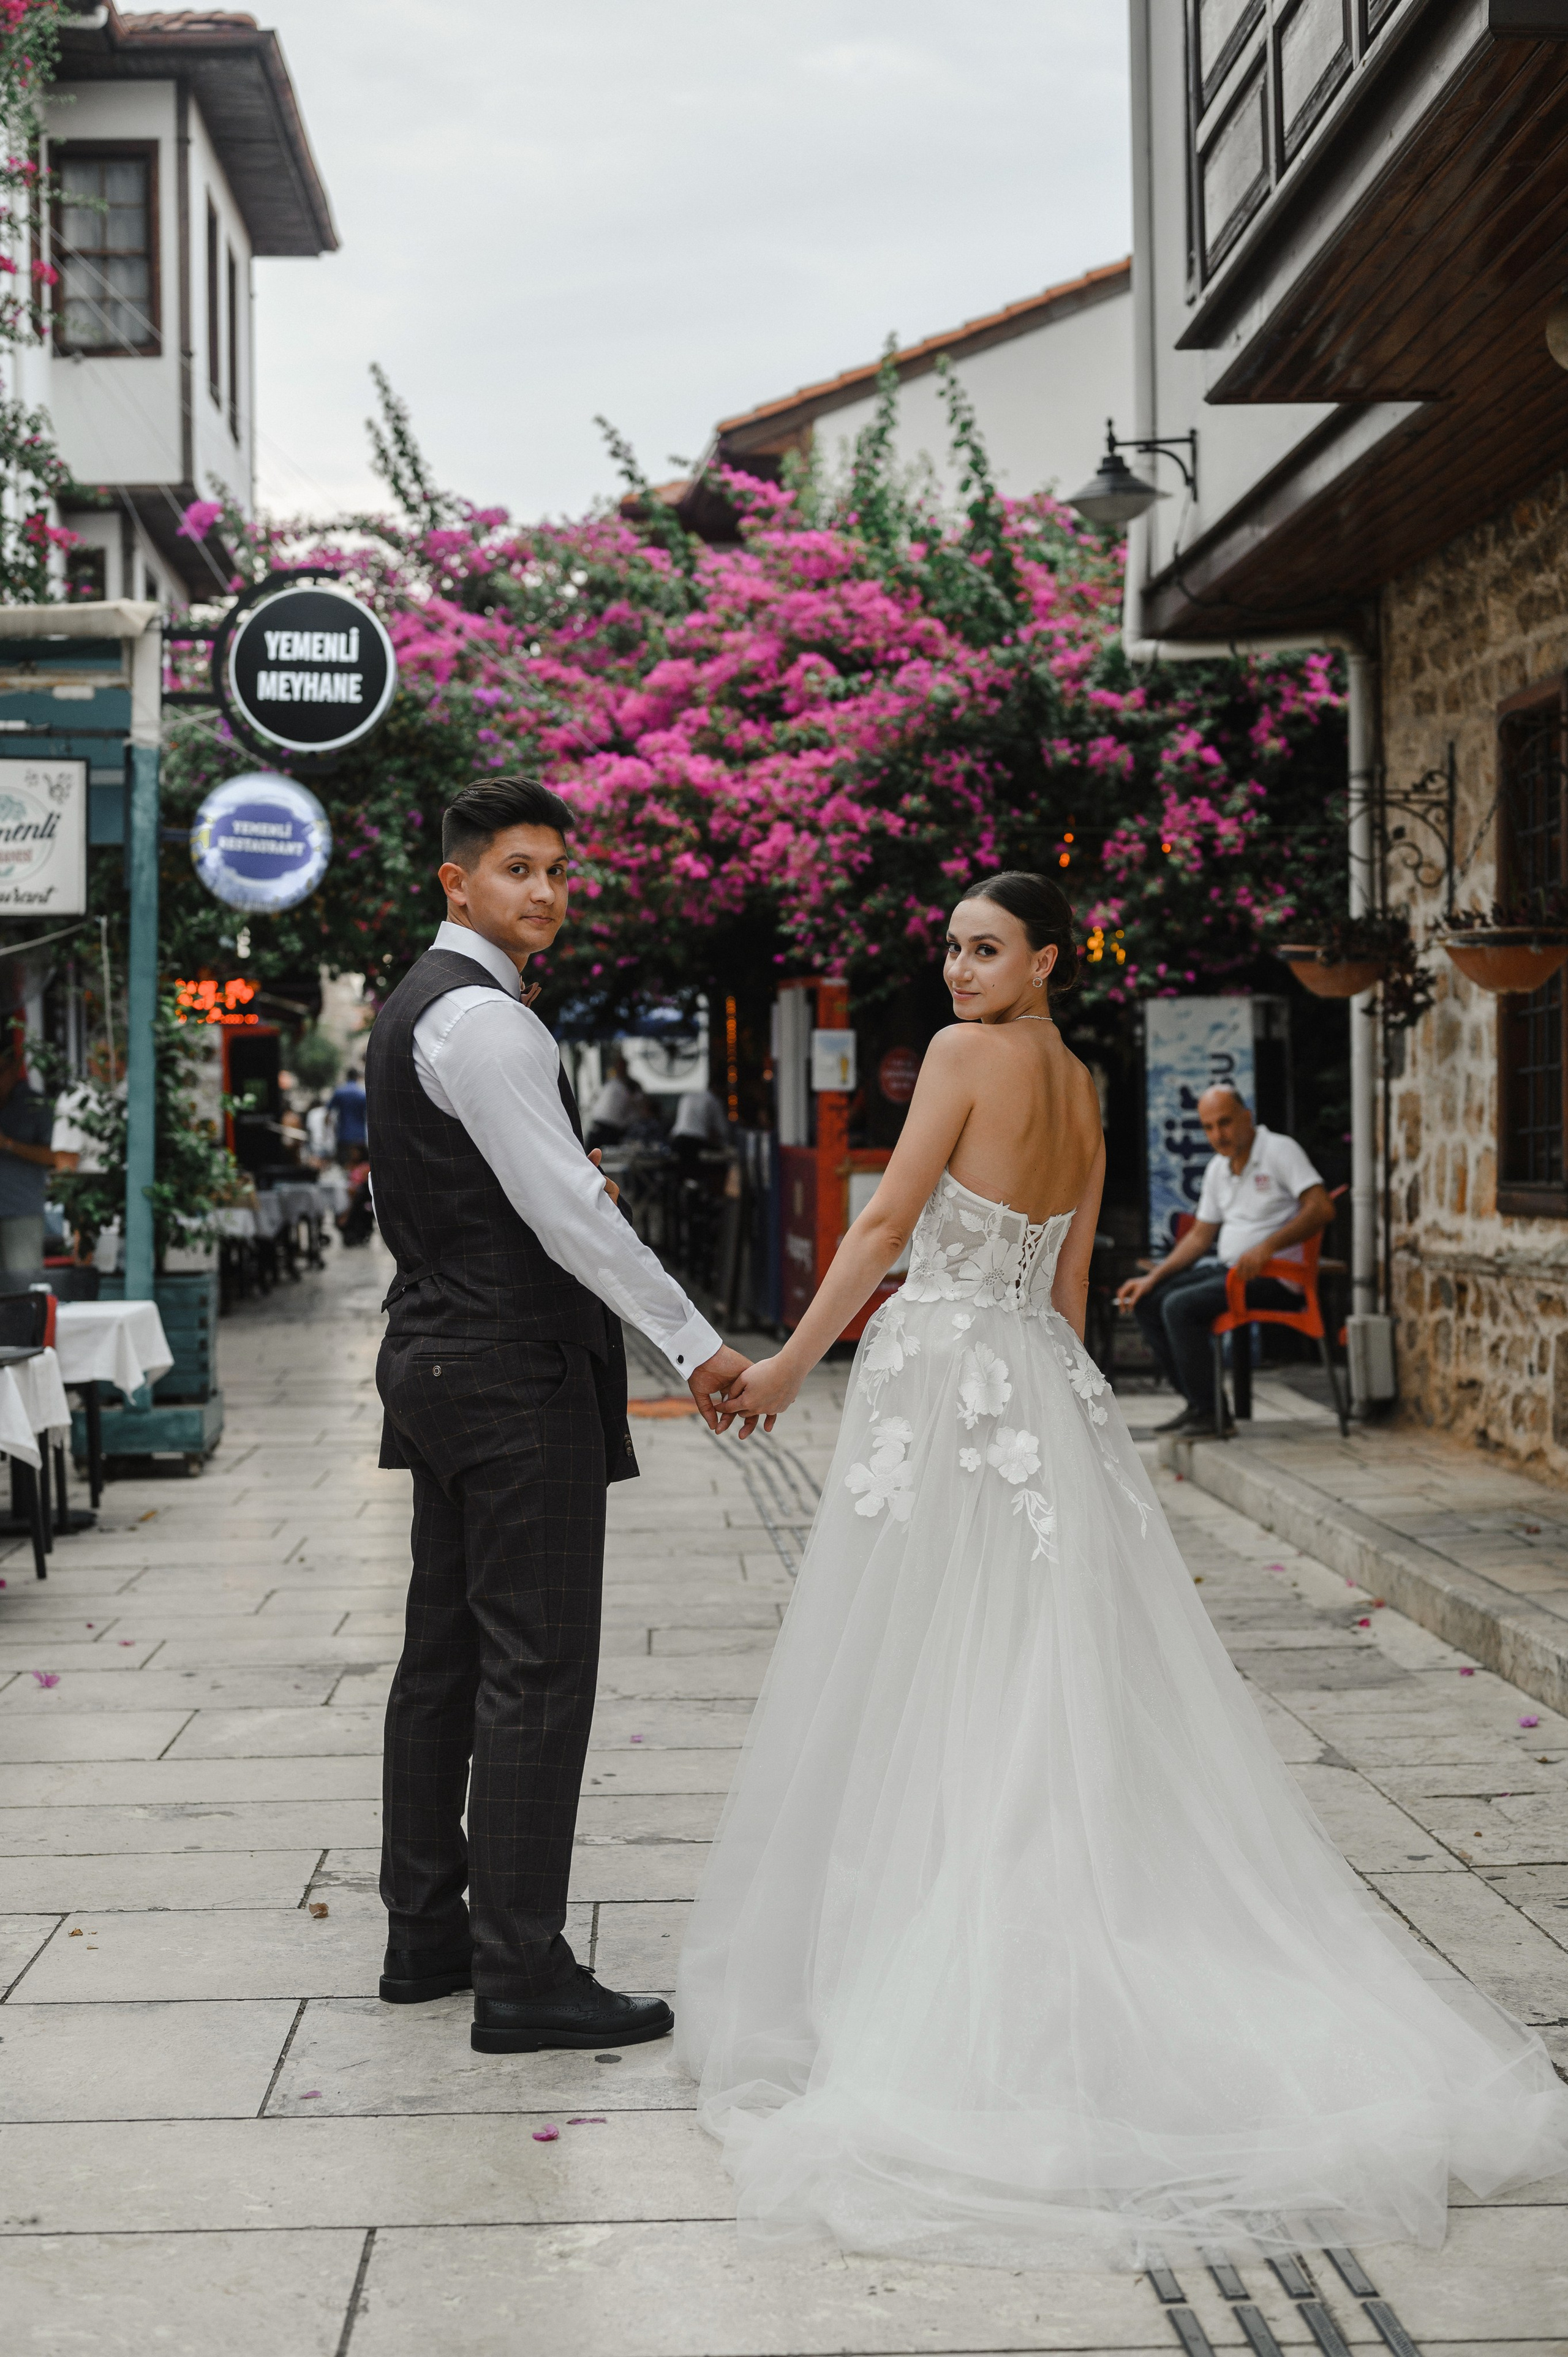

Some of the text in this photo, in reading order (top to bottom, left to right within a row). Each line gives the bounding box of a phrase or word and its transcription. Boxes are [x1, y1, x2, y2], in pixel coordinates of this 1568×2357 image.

[264, 627, 360, 663] YEMENLİ
[257, 670, 363, 704] MEYHANE
[217, 835, 306, 857] RESTAURANT
